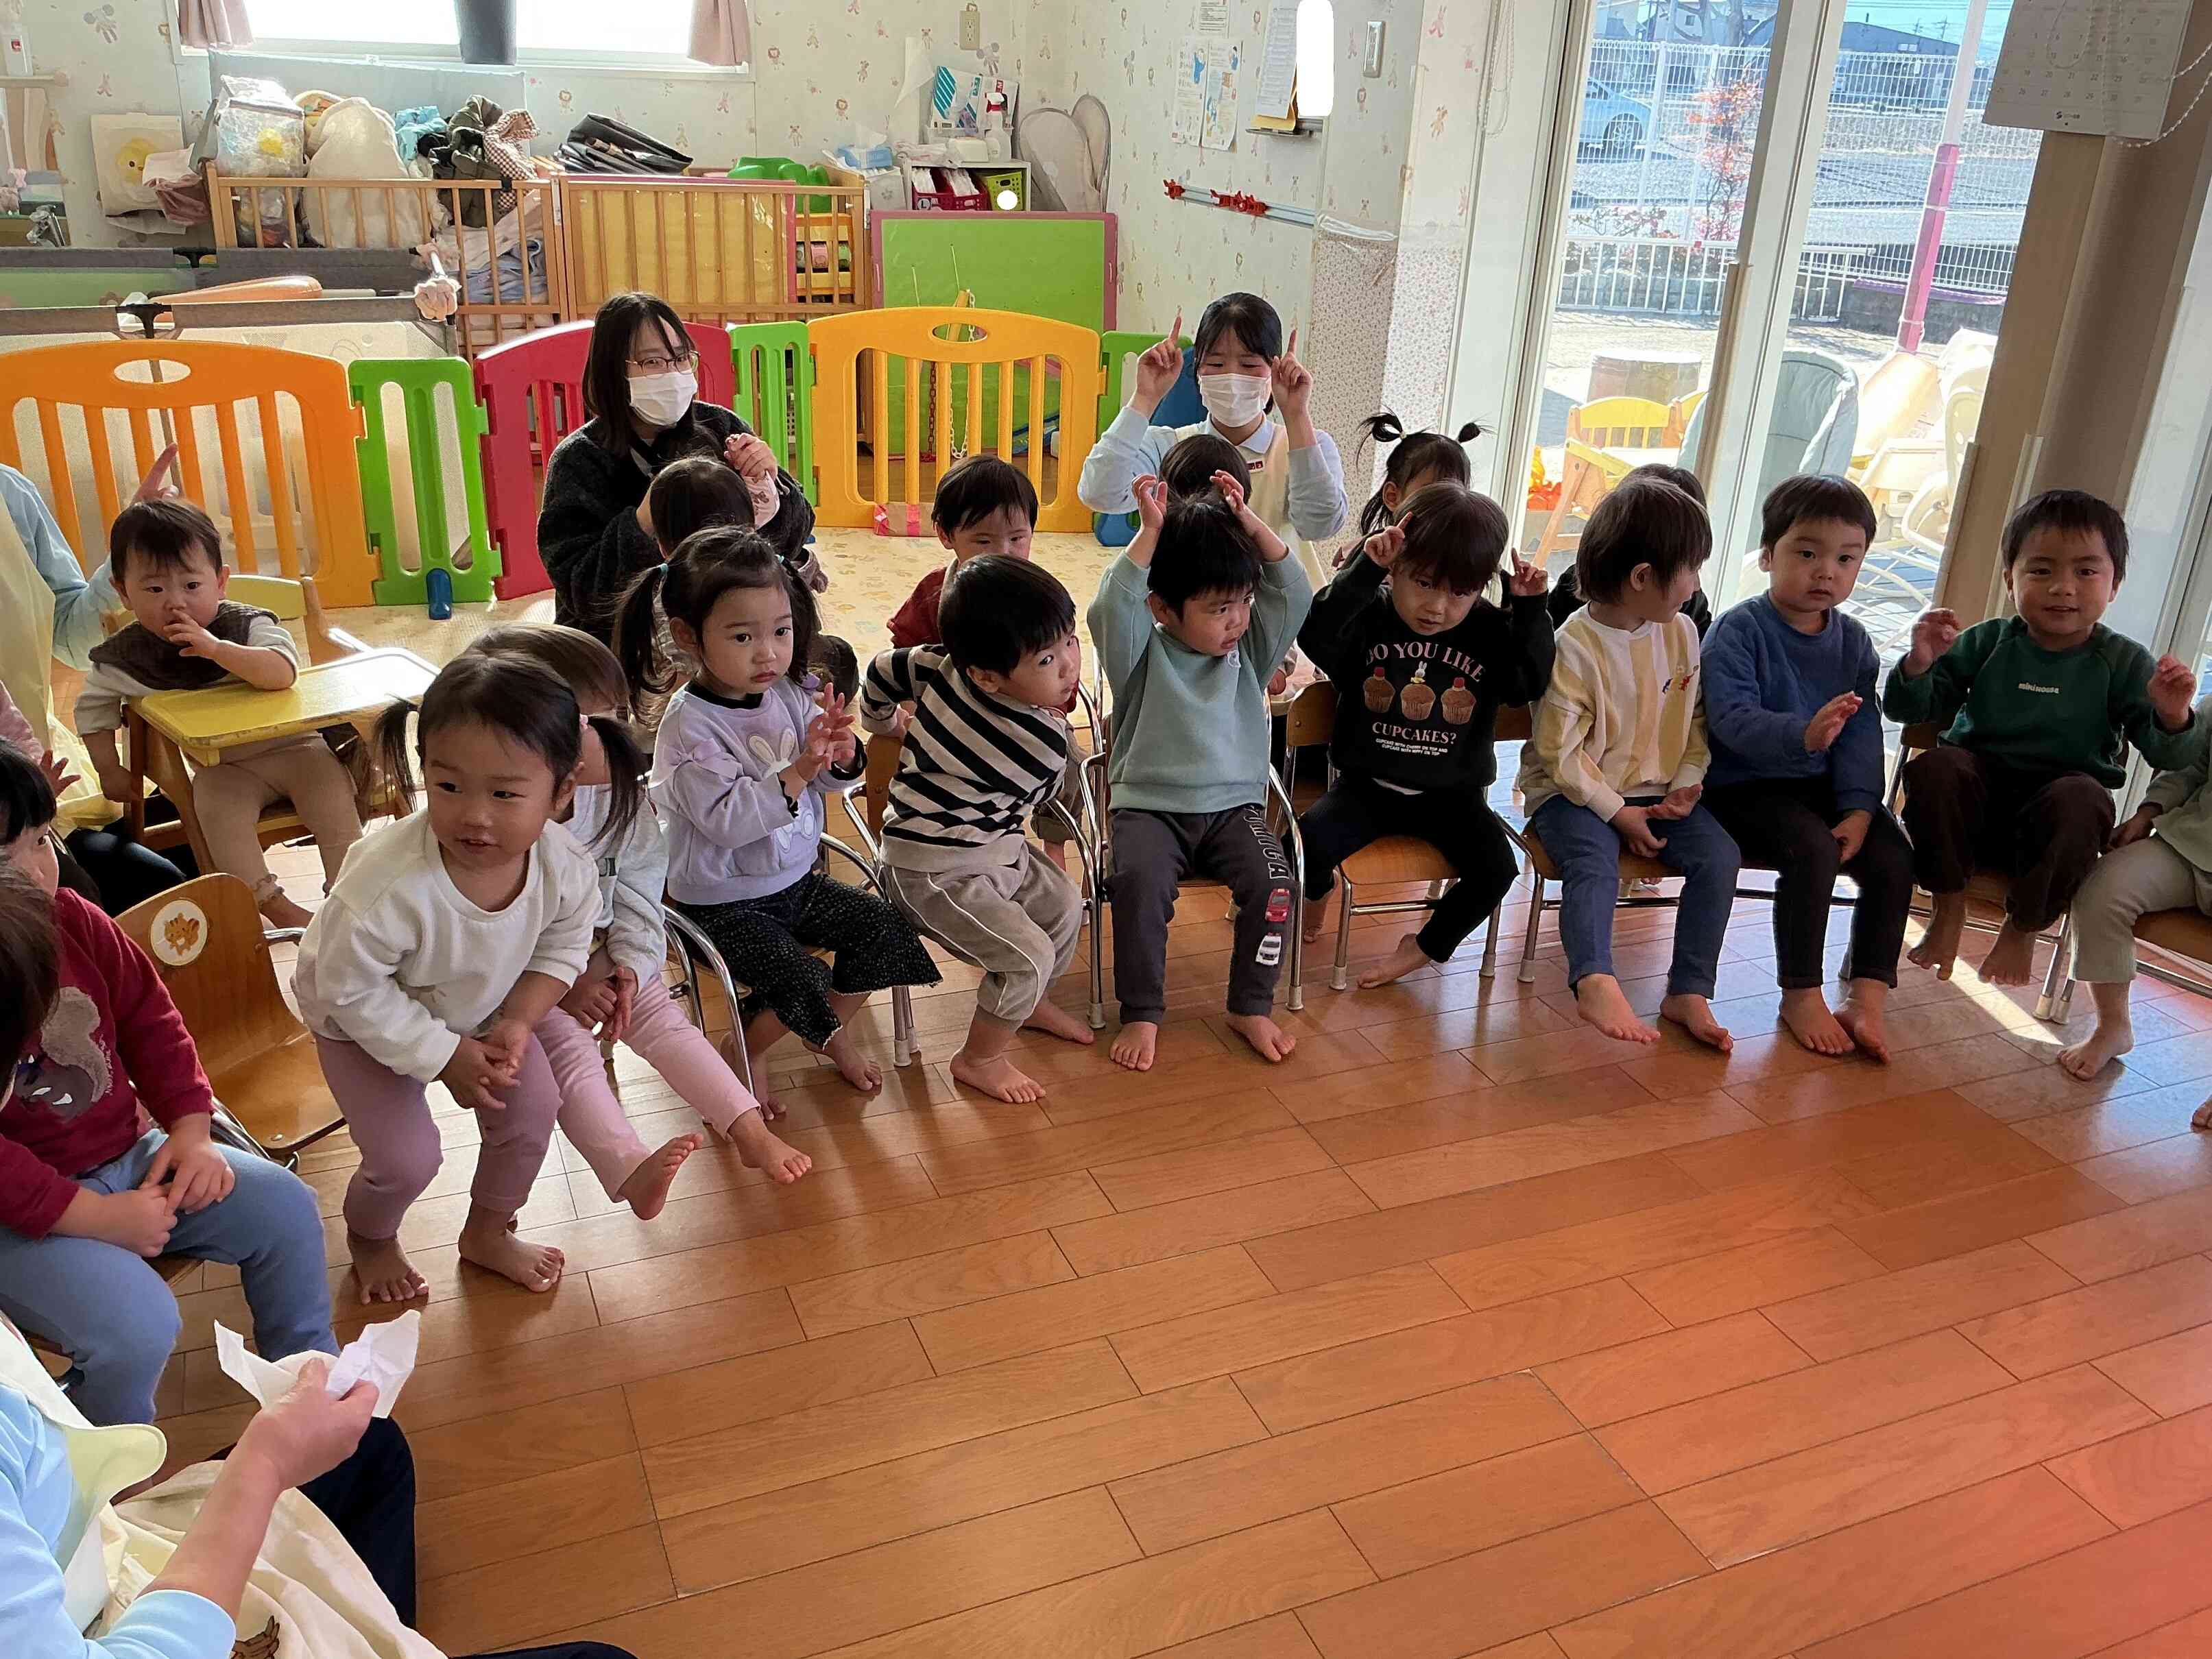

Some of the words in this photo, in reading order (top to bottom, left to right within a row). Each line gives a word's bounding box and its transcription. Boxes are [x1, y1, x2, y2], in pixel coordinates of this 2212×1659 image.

[1393, 641, 1439, 659] YOU
[1442, 646, 1487, 682] LIKE
[1372, 722, 1456, 744] CUPCAKES?
